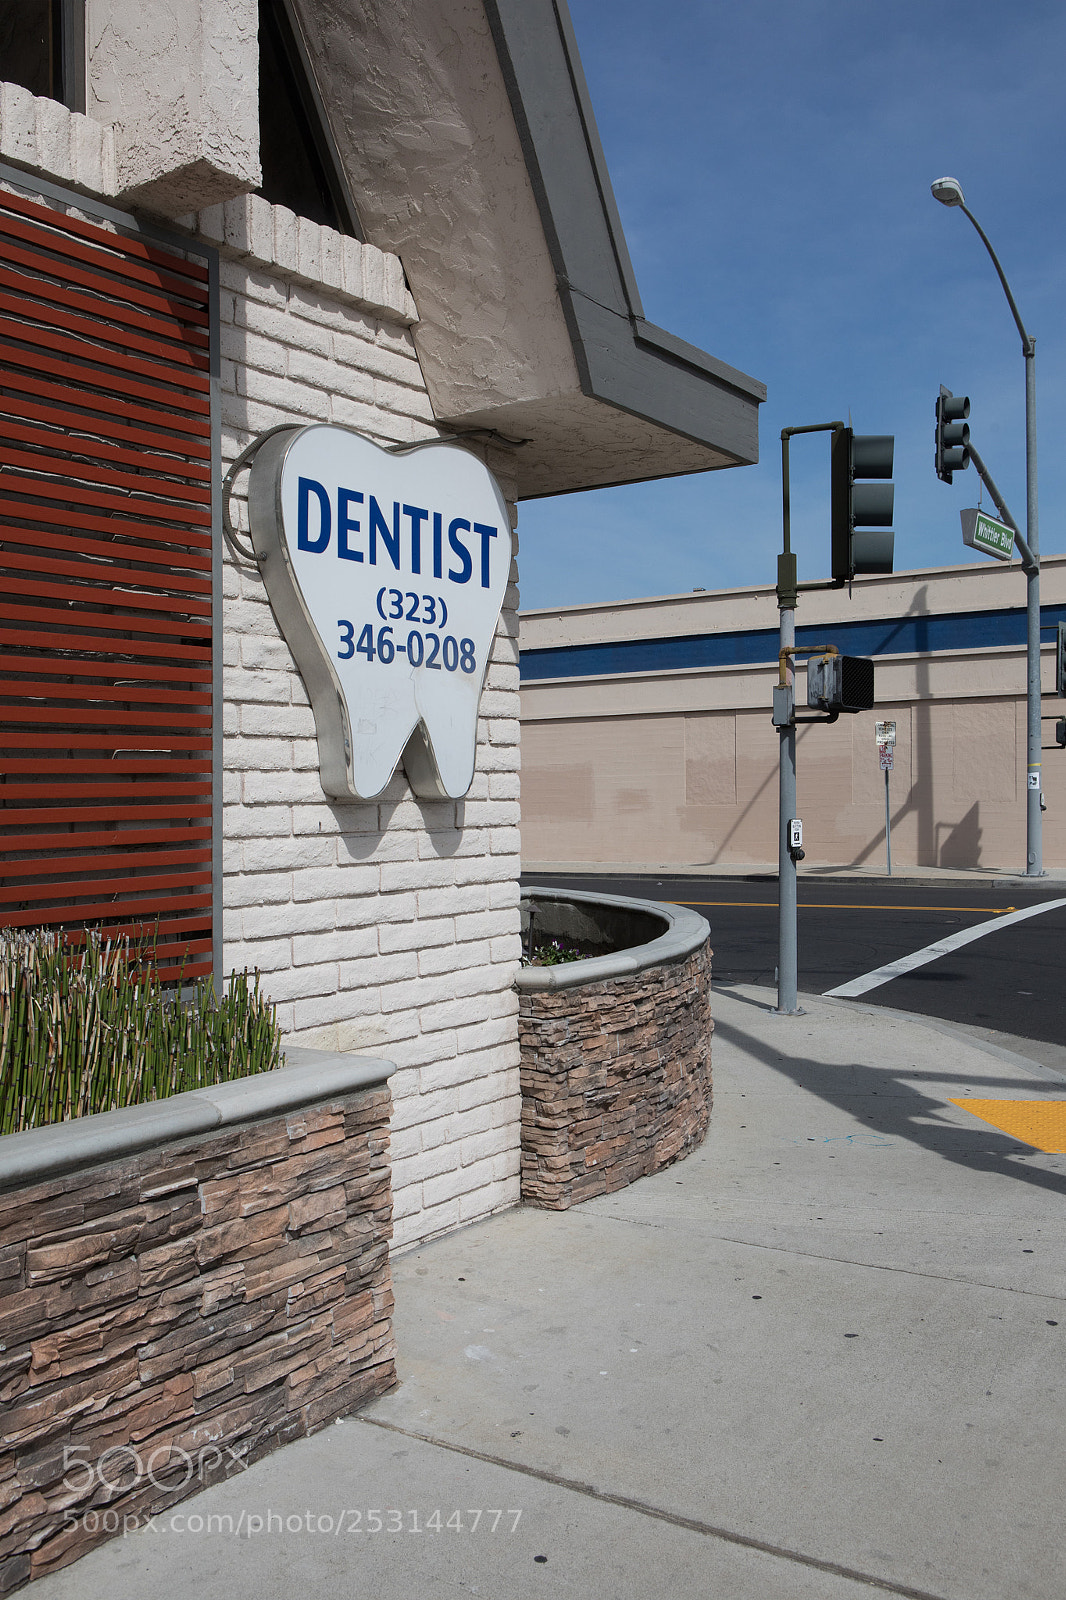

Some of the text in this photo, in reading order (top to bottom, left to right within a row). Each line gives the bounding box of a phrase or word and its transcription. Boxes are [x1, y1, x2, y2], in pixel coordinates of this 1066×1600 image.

[297, 476, 498, 589] DENTIST
[978, 521, 1012, 550] Whittier Blvd
[376, 586, 448, 629] (323)
[337, 619, 477, 674] 346-0208
